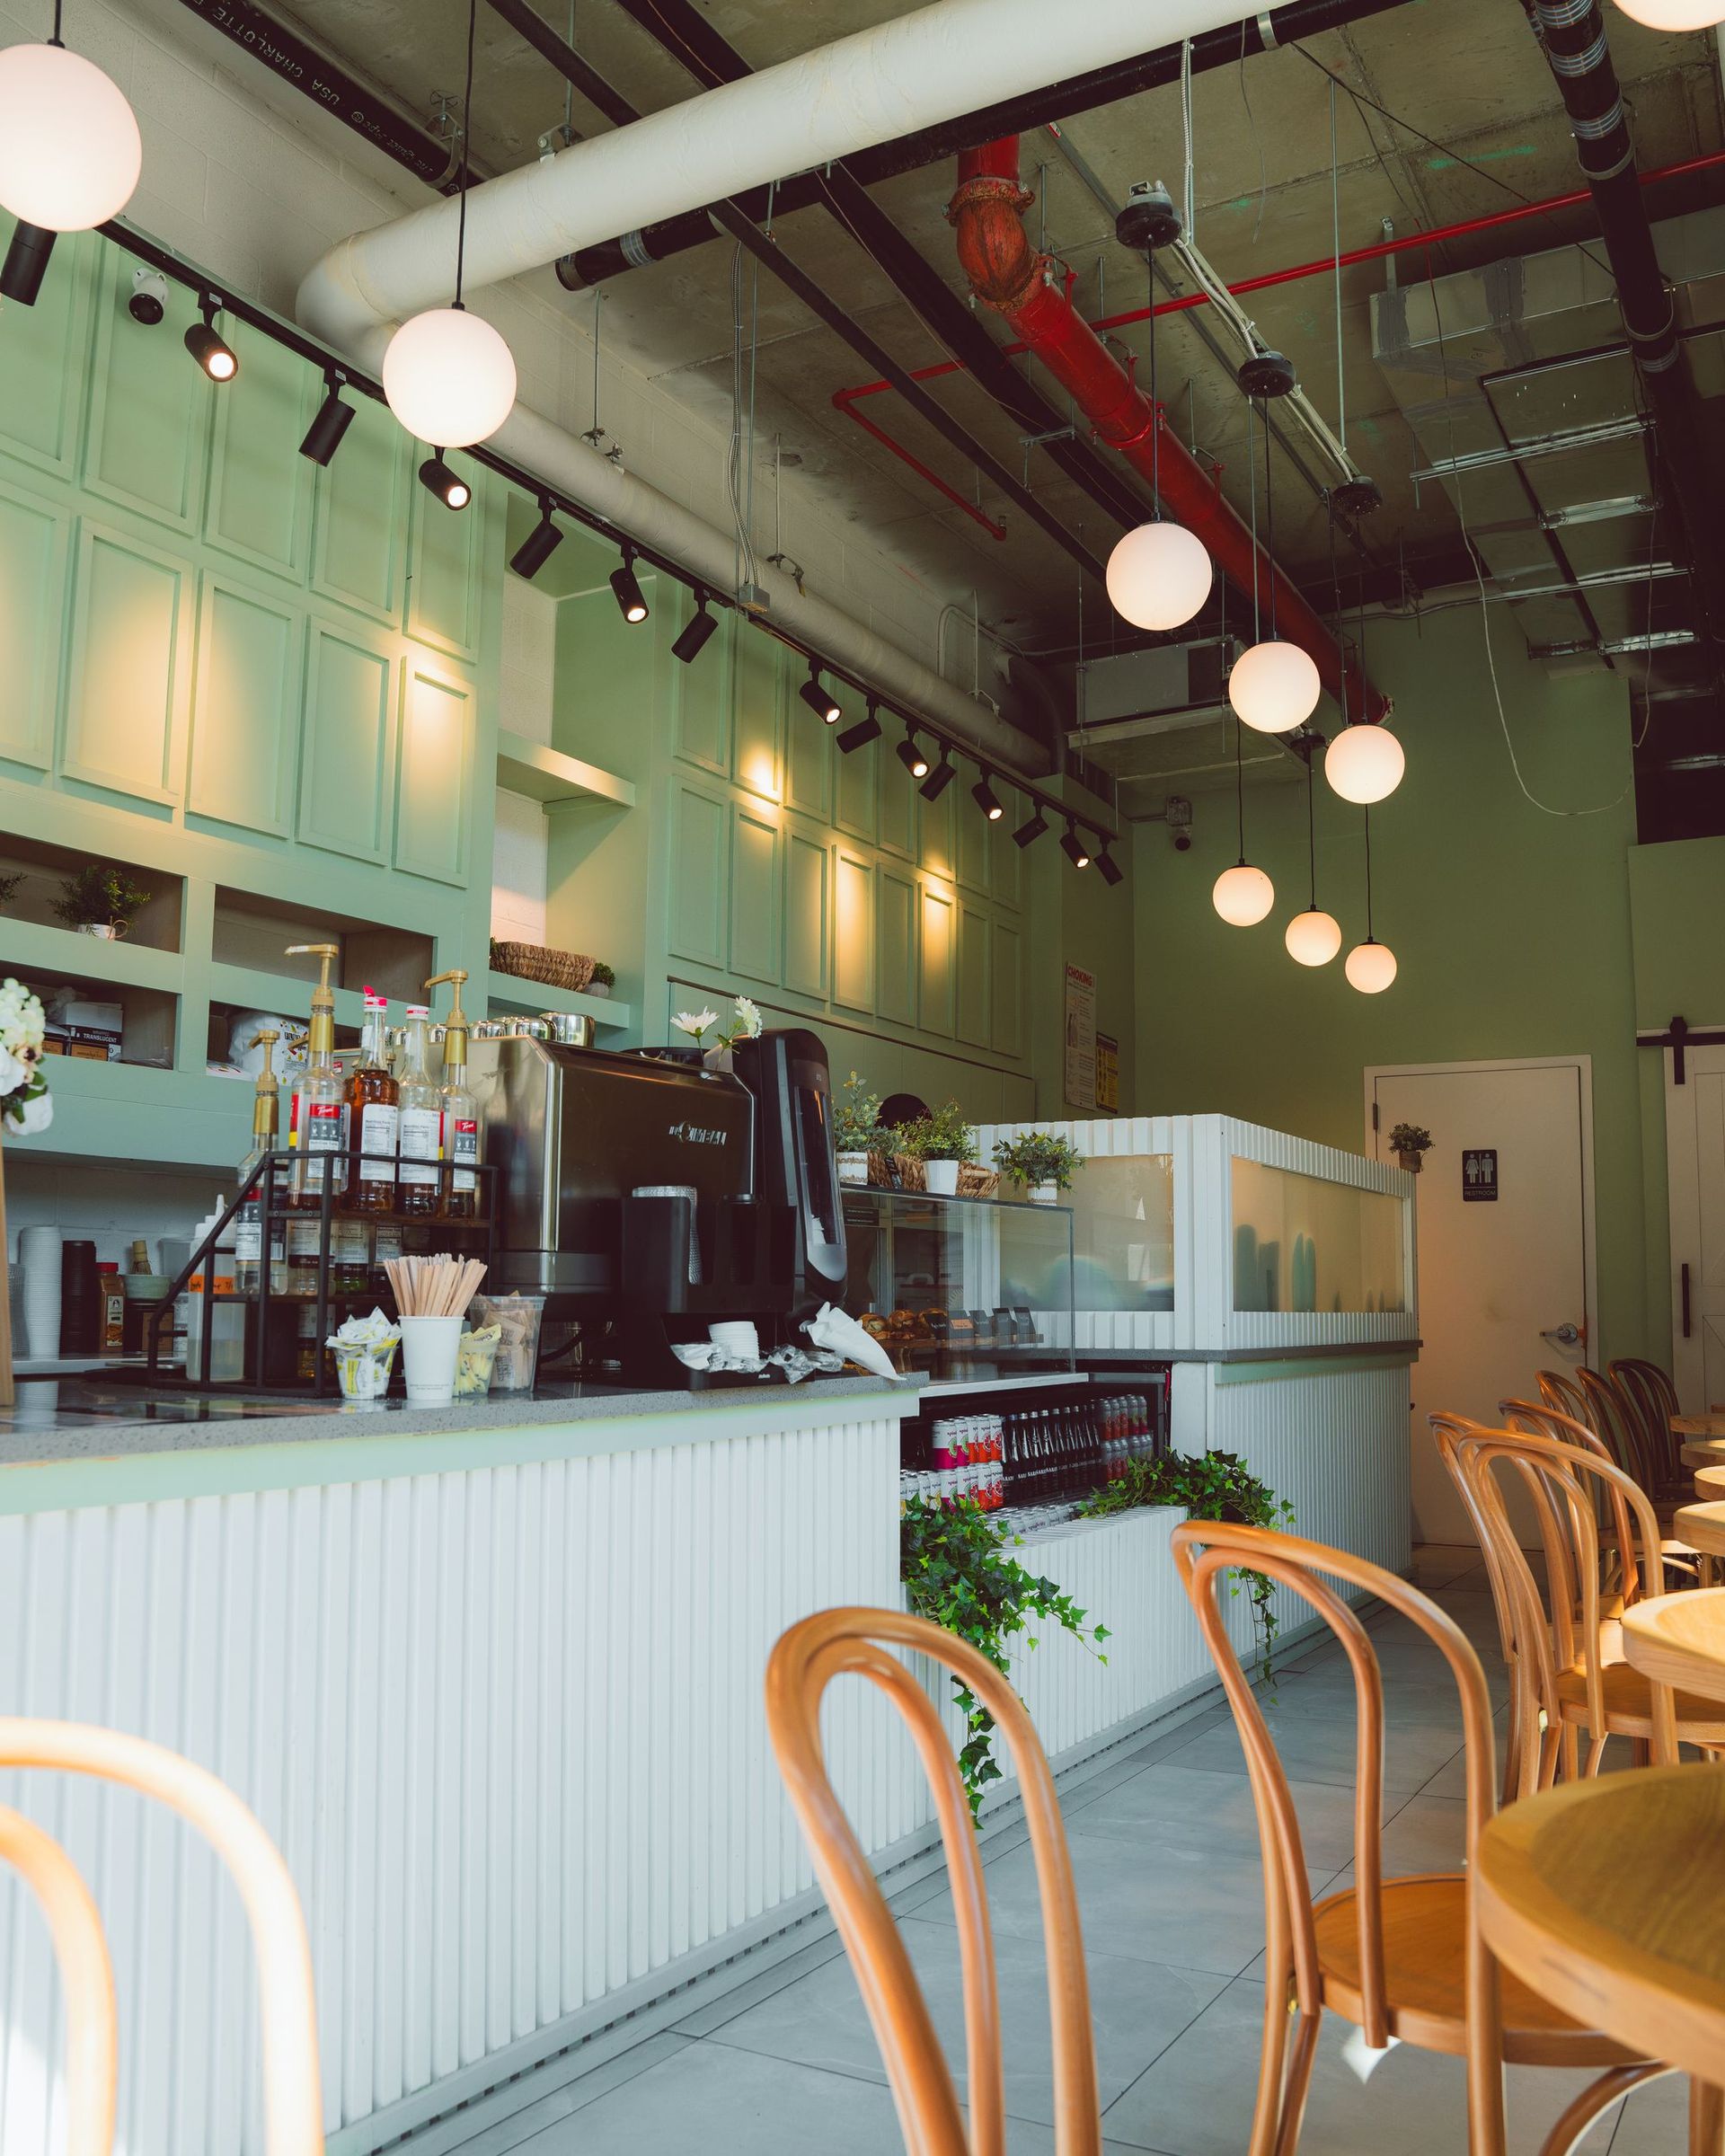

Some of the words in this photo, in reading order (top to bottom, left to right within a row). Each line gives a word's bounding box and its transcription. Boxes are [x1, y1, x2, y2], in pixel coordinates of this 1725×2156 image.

[212, 6, 304, 78] CHARLOTTE
[311, 78, 341, 106] USA
[1067, 966, 1093, 986] CHOKING
[83, 1032, 117, 1043] TRANSLUCENT
